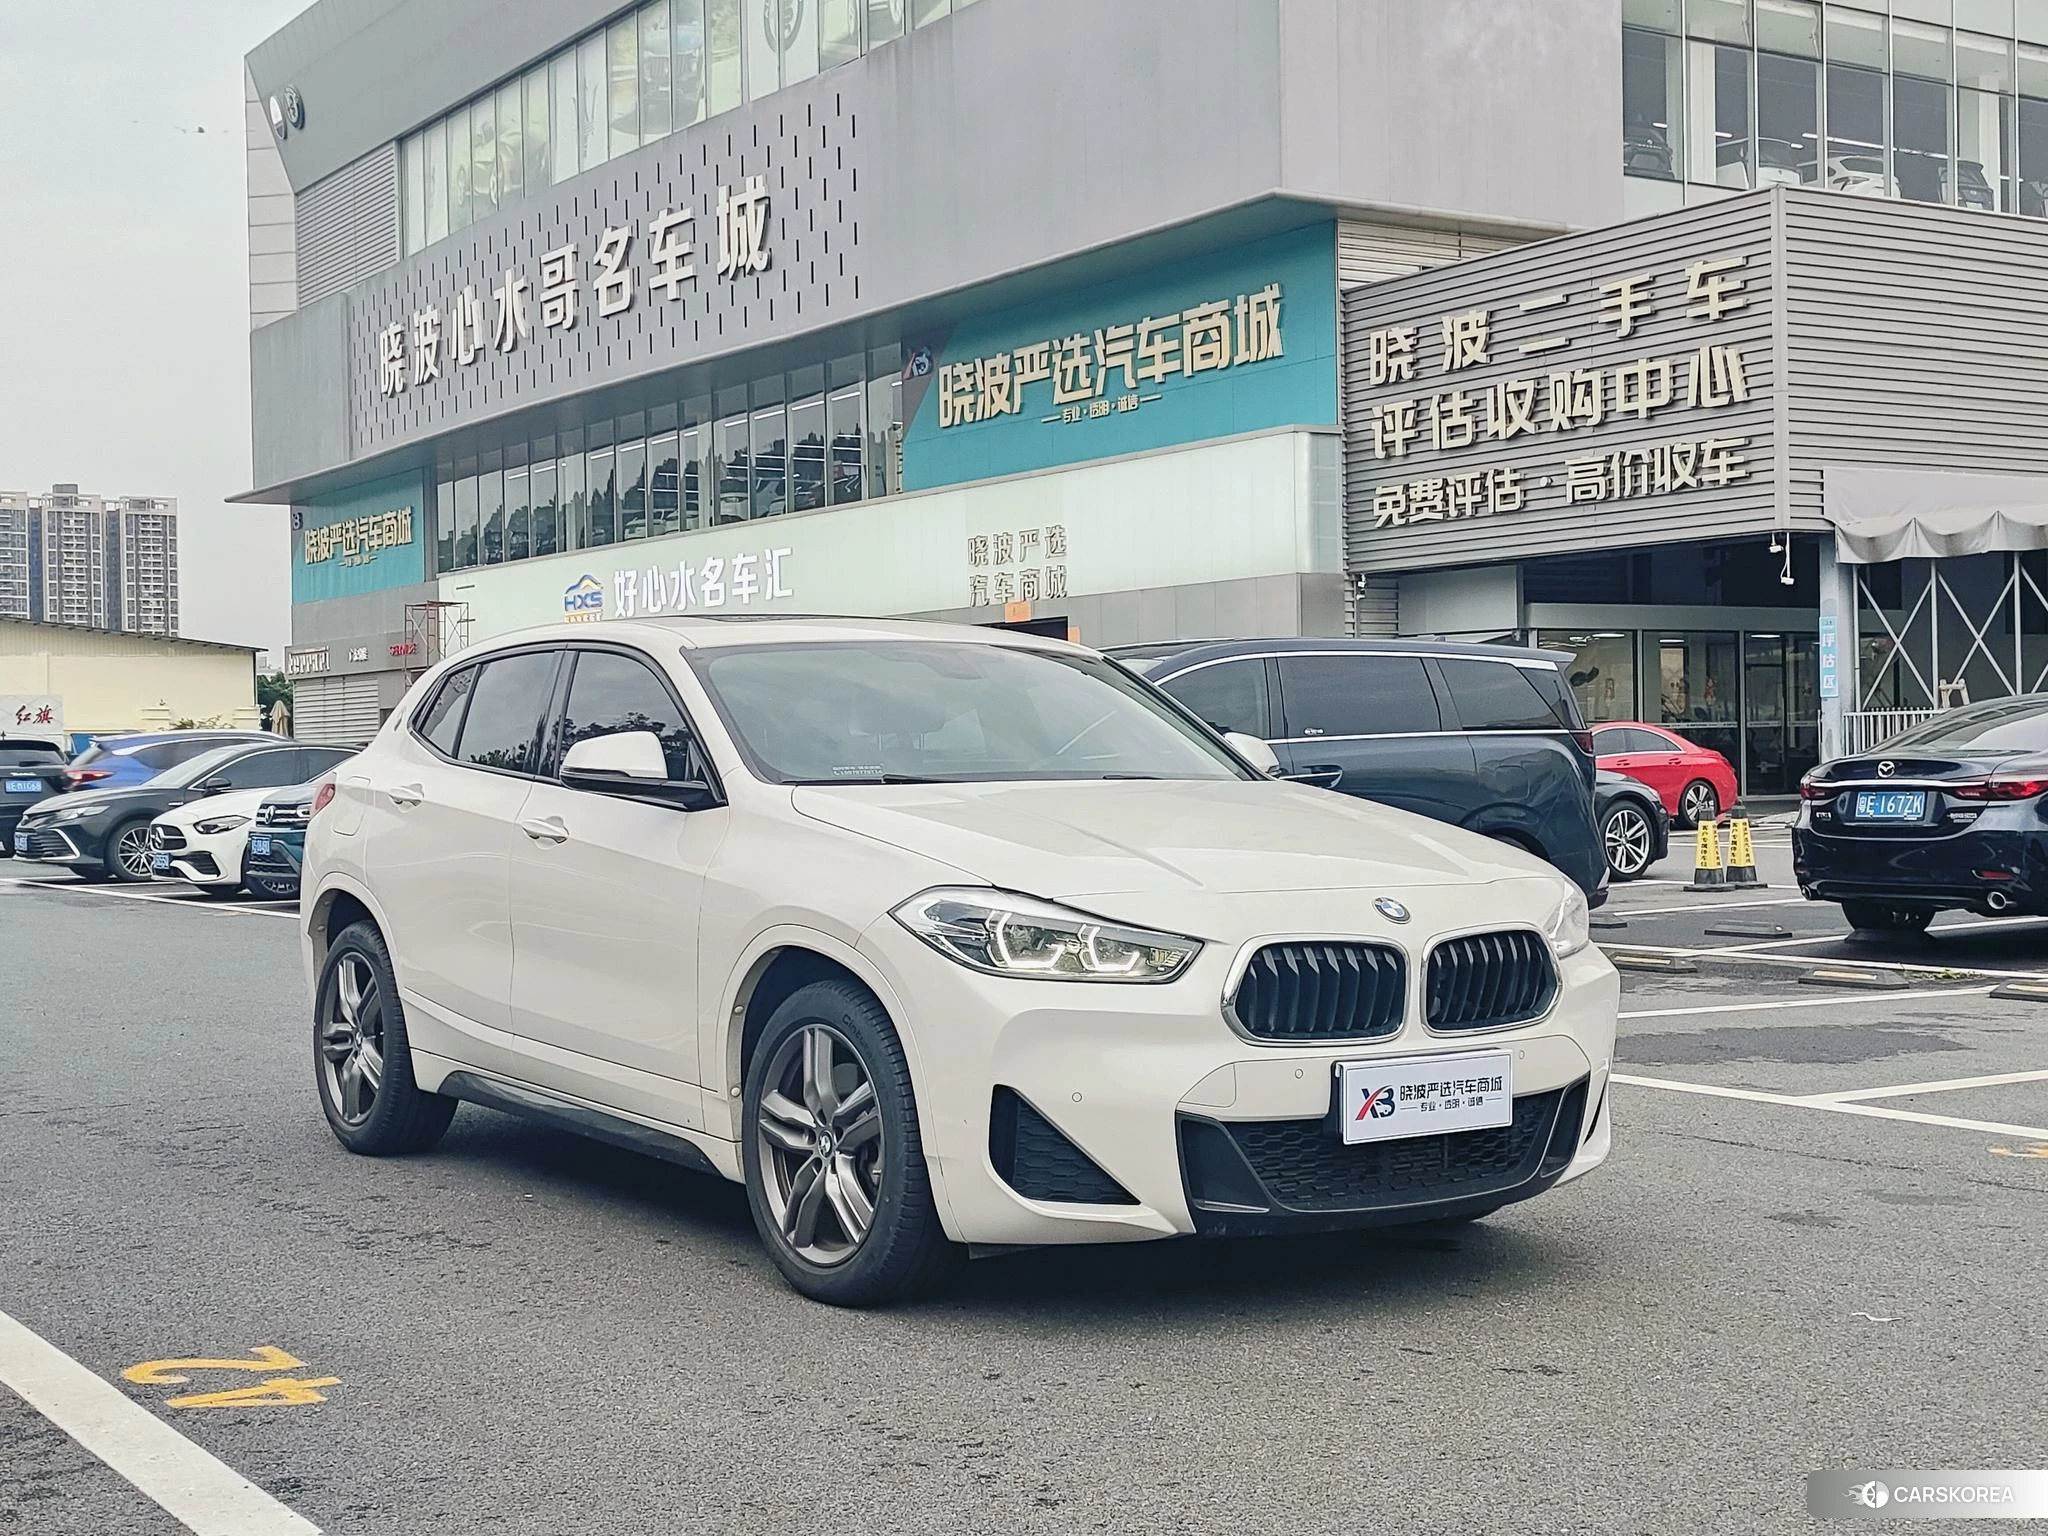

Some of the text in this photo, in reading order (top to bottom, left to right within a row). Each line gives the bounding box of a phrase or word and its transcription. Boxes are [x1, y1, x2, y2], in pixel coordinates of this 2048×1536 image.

[378, 175, 772, 398] 晓波心水哥名车城
[1369, 256, 1749, 386] 晓波二手车
[938, 284, 1284, 429] 晓波严选汽车商城
[1372, 346, 1750, 460] 评估收购中心
[1373, 437, 1751, 529] 免费评估·高价收车
[304, 506, 413, 565] 晓波严选汽车商城
[968, 525, 1067, 567] 晓波严选
[564, 591, 603, 612] HXS
[613, 547, 794, 618] 好心水名车汇
[969, 565, 1068, 607] 汽车商城
[15, 704, 54, 725] 红旗
[1399, 1075, 1503, 1102] 晓波严选汽车商城
